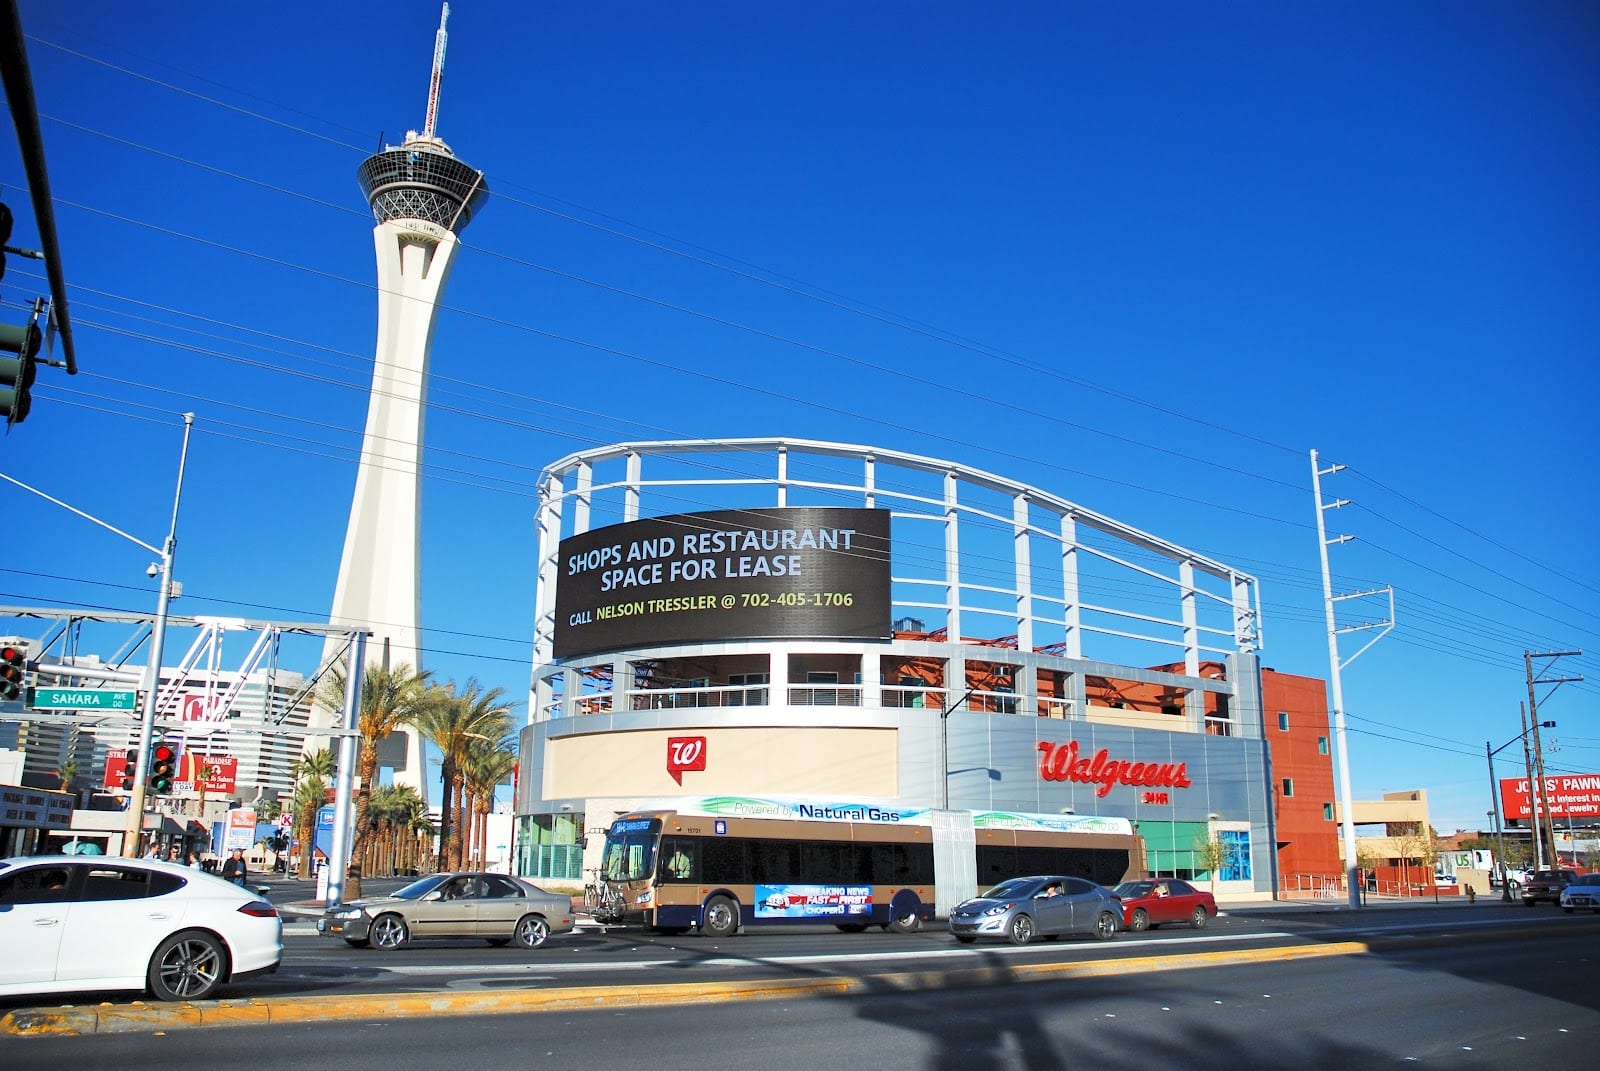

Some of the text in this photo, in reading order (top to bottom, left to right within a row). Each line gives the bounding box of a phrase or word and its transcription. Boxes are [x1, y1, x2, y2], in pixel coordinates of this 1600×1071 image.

[568, 528, 855, 576] SHOPS AND RESTAURANT
[601, 555, 801, 592] SPACE FOR LEASE
[569, 592, 853, 627] CALL NELSON TRESSLER @ 702-405-1706
[52, 693, 101, 706] SAHARA
[113, 692, 127, 701] AVE
[671, 739, 703, 766] W
[1037, 740, 1192, 797] Walgreens
[734, 802, 900, 822] Powered by Natural Gas
[806, 895, 830, 905] FAST
[838, 895, 868, 905] FIRST
[846, 888, 870, 897] NEWS
